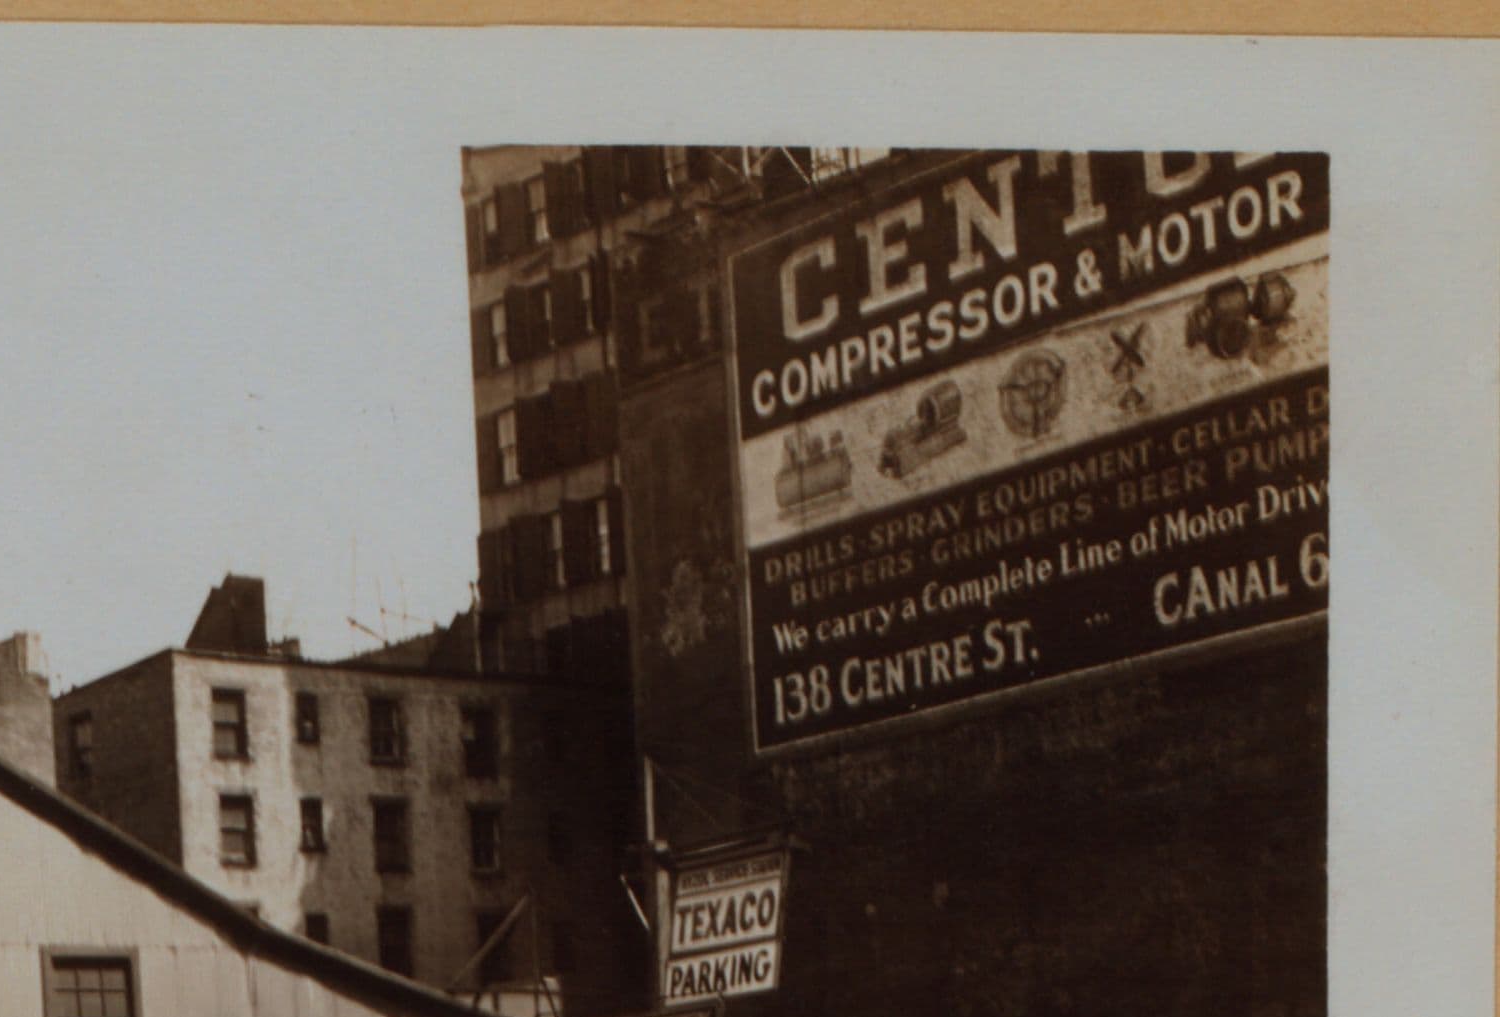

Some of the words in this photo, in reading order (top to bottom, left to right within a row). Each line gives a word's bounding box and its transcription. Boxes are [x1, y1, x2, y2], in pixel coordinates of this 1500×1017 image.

[751, 263, 1060, 417] COMPRESSOR
[1074, 250, 1102, 297] &
[1118, 170, 1304, 281] MOTOR
[764, 534, 855, 584] DRILLS
[868, 501, 965, 550] SPRAY
[977, 437, 1153, 518] EQUIPMENT
[1172, 396, 1290, 455] CELLAR
[790, 551, 914, 607] BUFFERS
[931, 493, 1093, 565] GRINDERS
[1118, 459, 1207, 509] BEER
[772, 622, 809, 653] We
[815, 602, 896, 637] carry
[902, 597, 917, 621] a
[922, 556, 1053, 613] Complete
[1060, 538, 1122, 577] Line
[1130, 515, 1157, 556] of
[1160, 502, 1247, 548] Motor
[773, 664, 831, 724] 138
[841, 635, 974, 705] CENTRE
[982, 619, 1040, 671] ST.
[1154, 555, 1289, 626] CANAL
[1300, 533, 1328, 588] 6
[670, 949, 771, 998] PARKING
[675, 888, 775, 944] TEXACO
